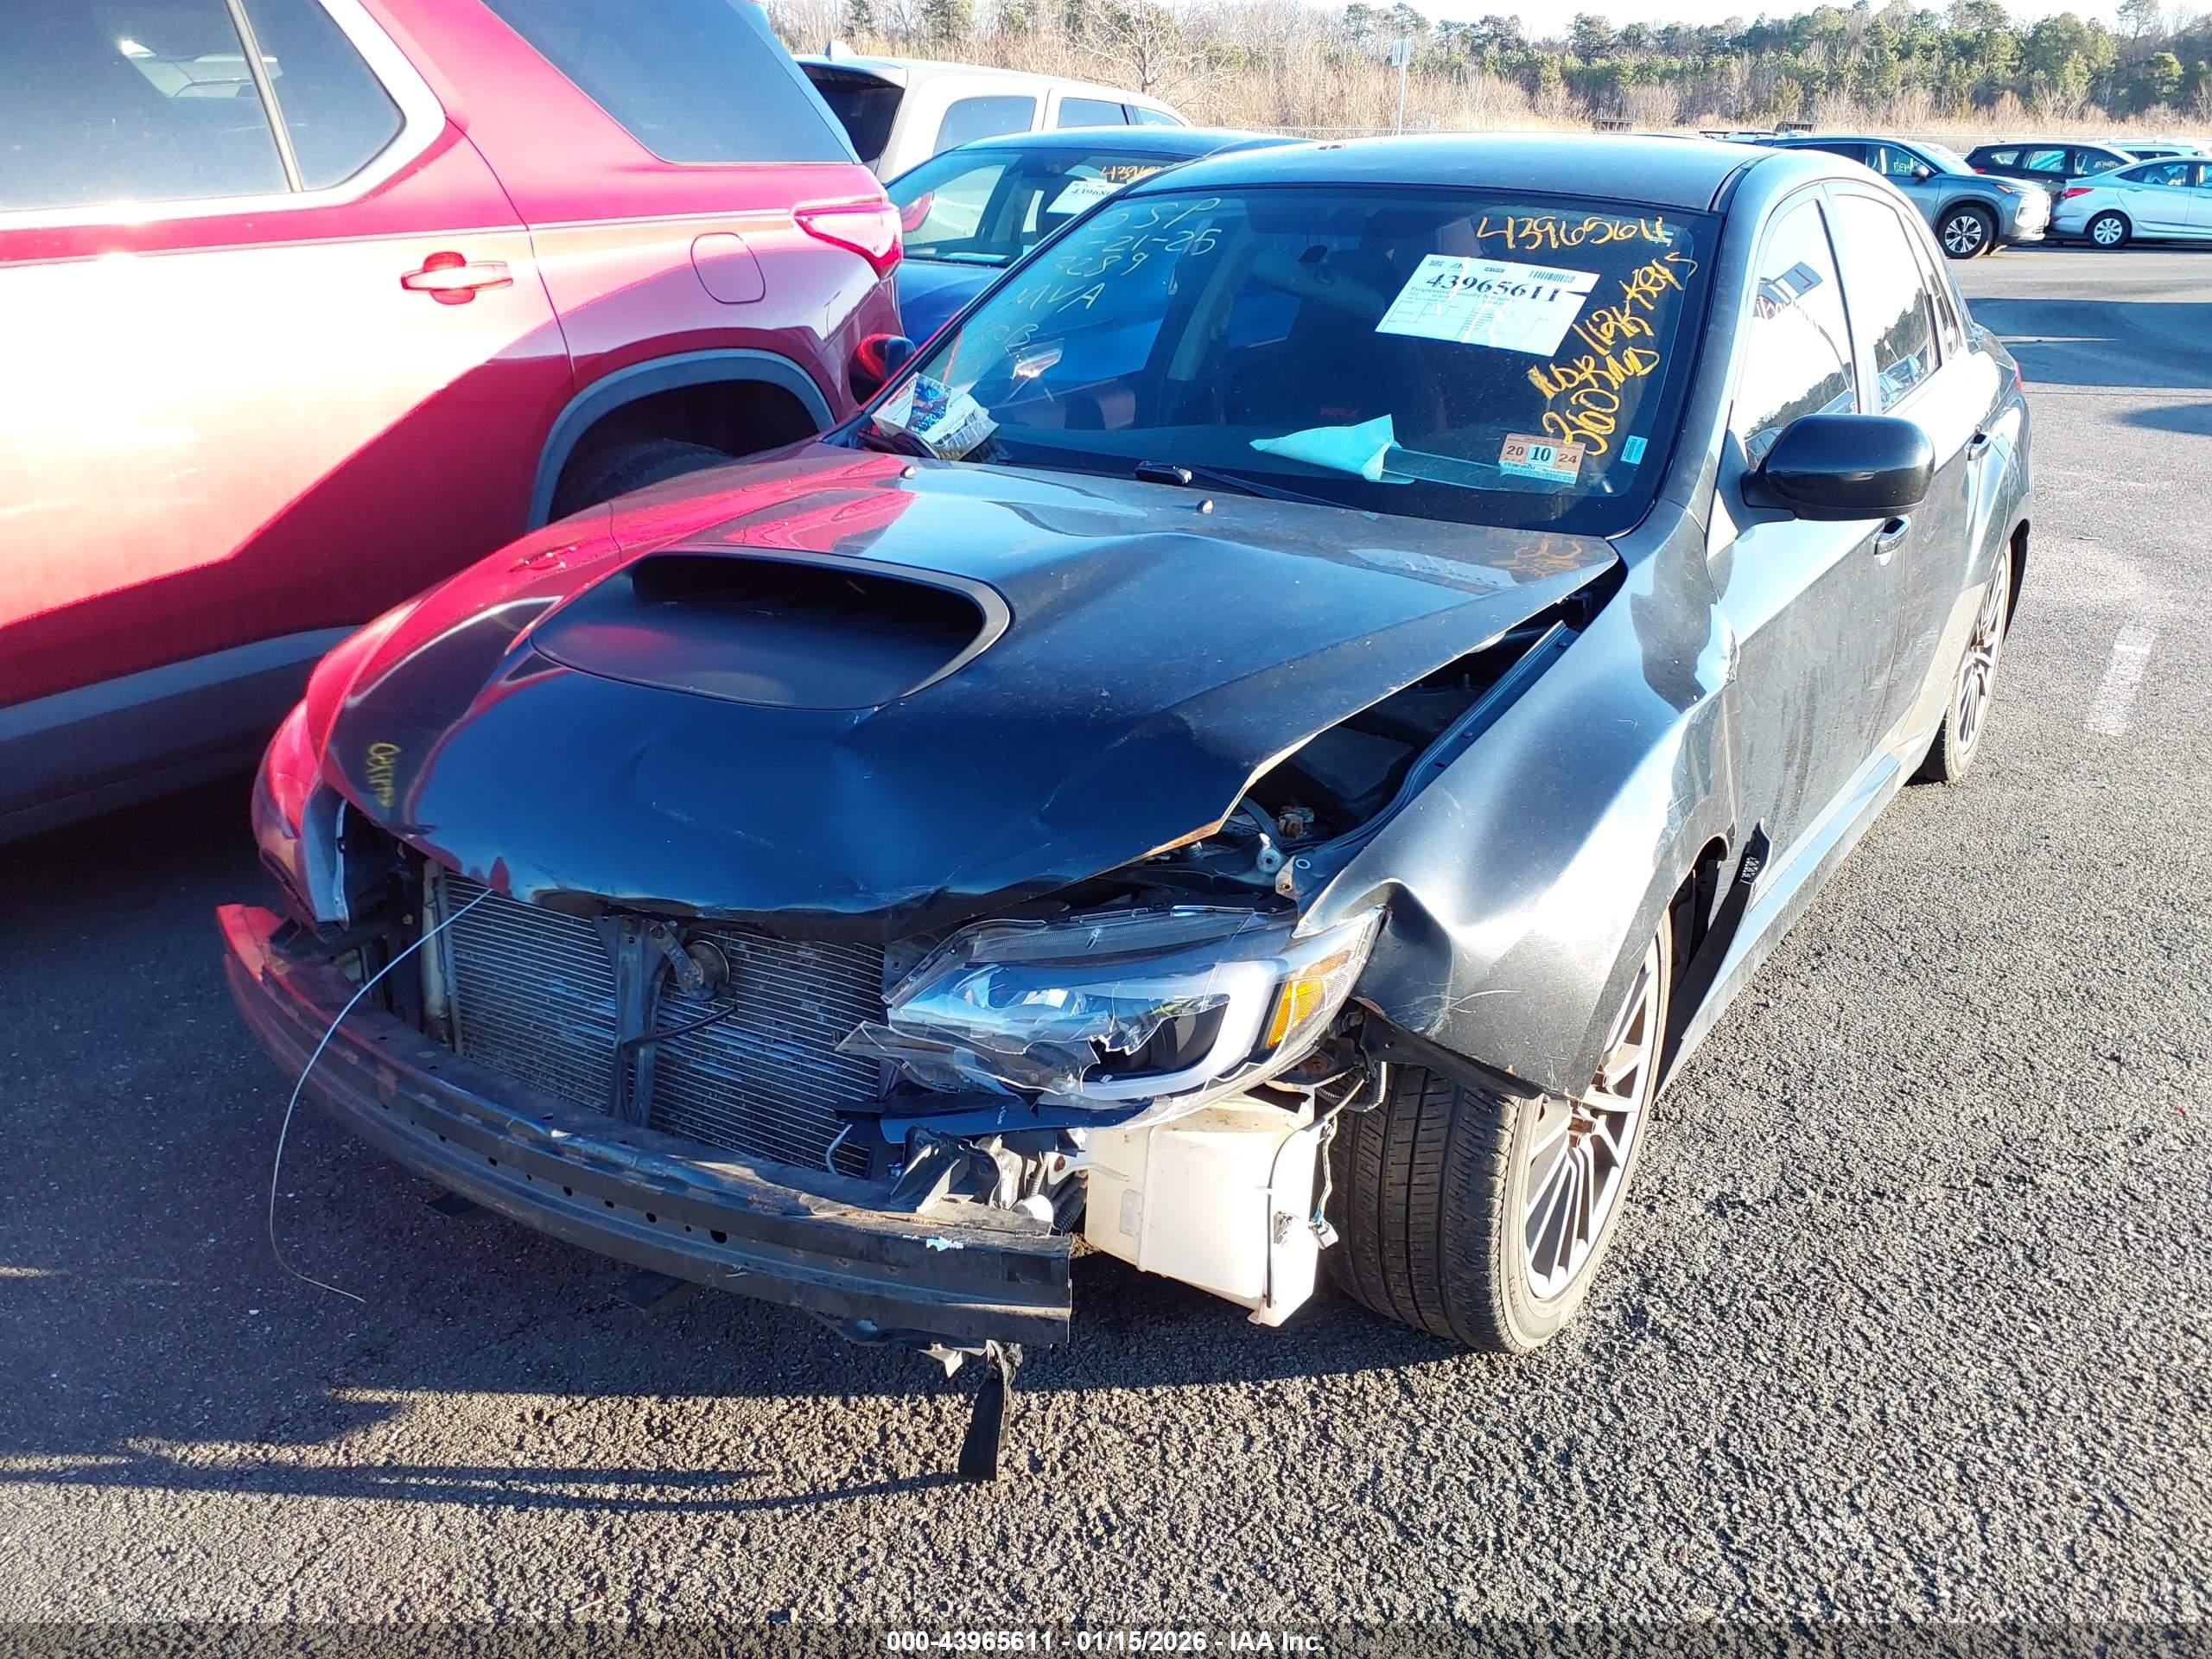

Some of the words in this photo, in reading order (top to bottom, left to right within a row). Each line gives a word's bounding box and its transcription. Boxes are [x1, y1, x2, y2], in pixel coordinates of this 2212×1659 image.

[1426, 273, 1561, 302] 43965611
[1506, 445, 1524, 456] 20
[1530, 446, 1552, 462] 10
[1558, 453, 1577, 464] 24
